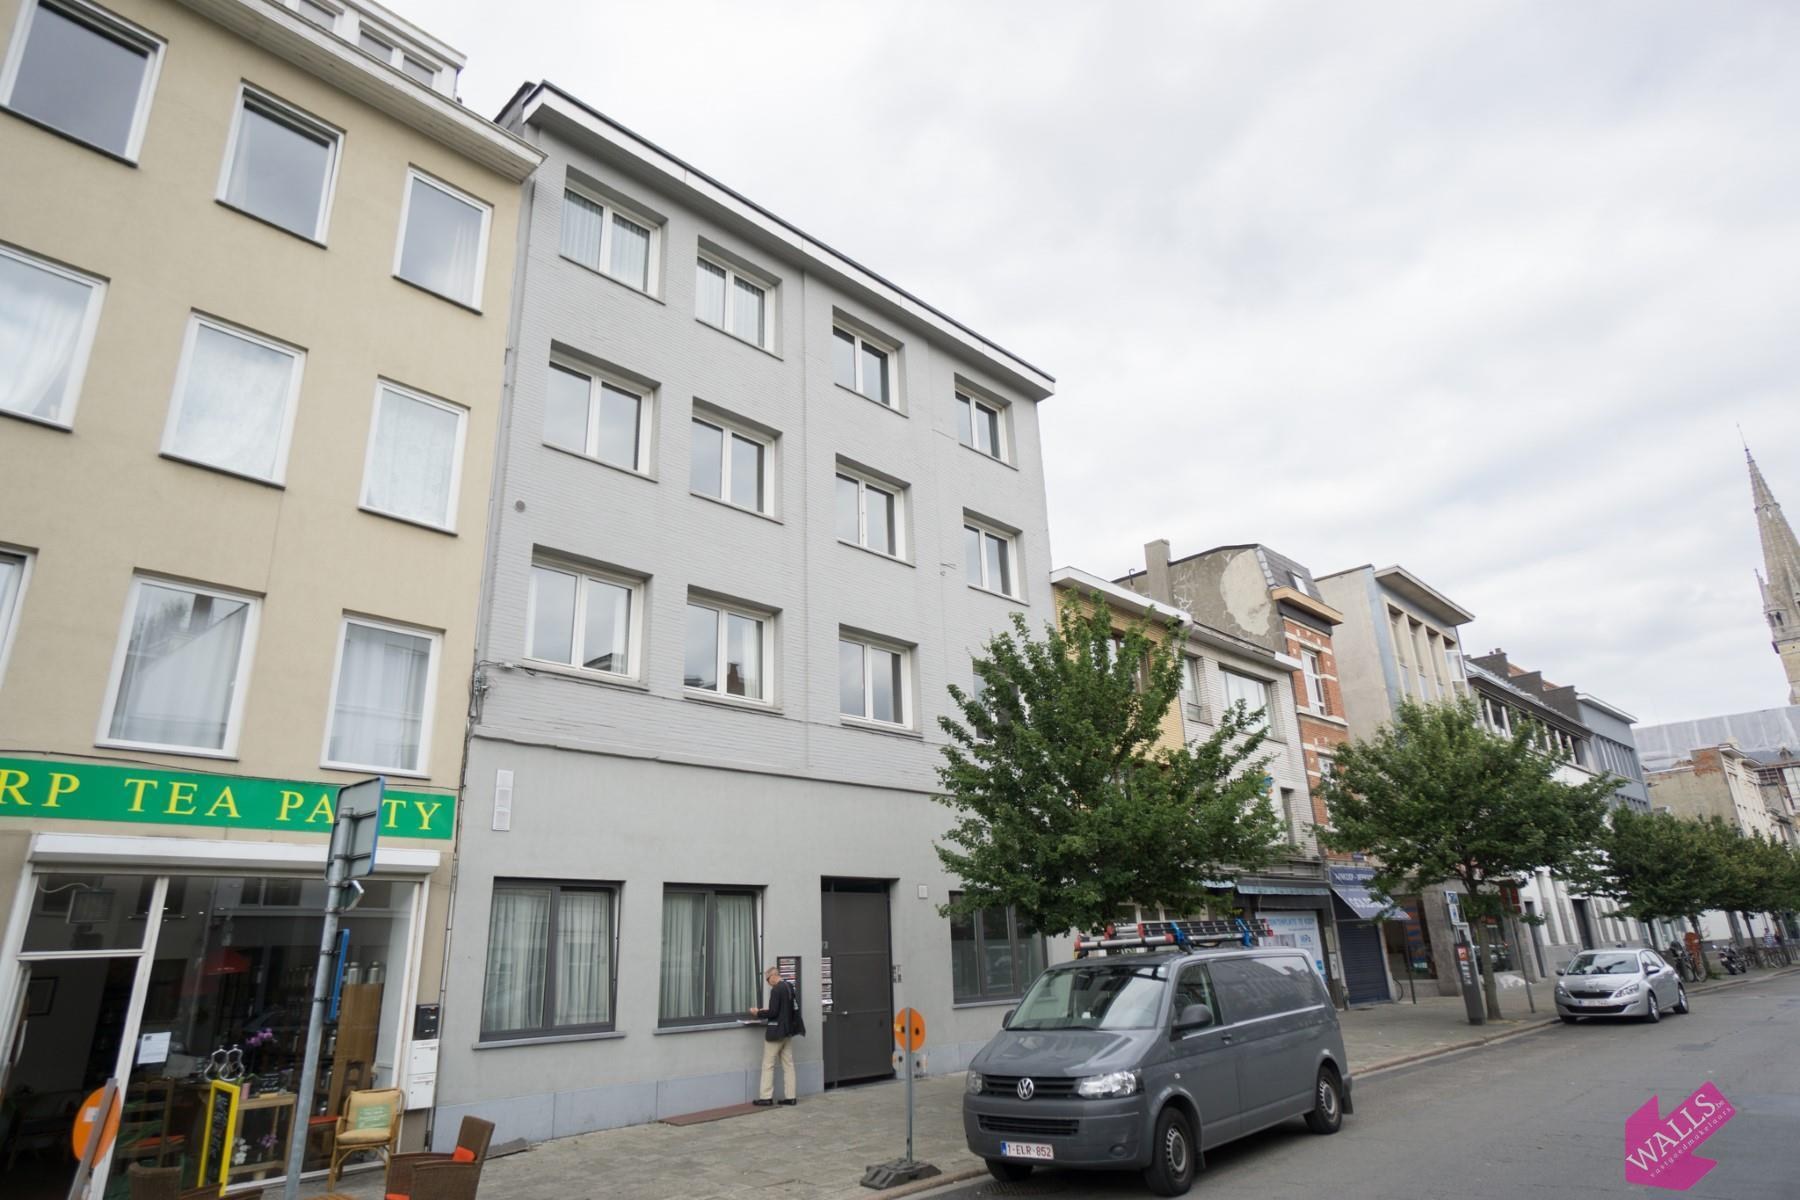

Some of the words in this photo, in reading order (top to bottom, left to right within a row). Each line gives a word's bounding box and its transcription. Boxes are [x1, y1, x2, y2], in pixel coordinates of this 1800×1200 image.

[0, 769, 80, 807] RP
[124, 778, 242, 818] TEA
[276, 790, 442, 831] PATY
